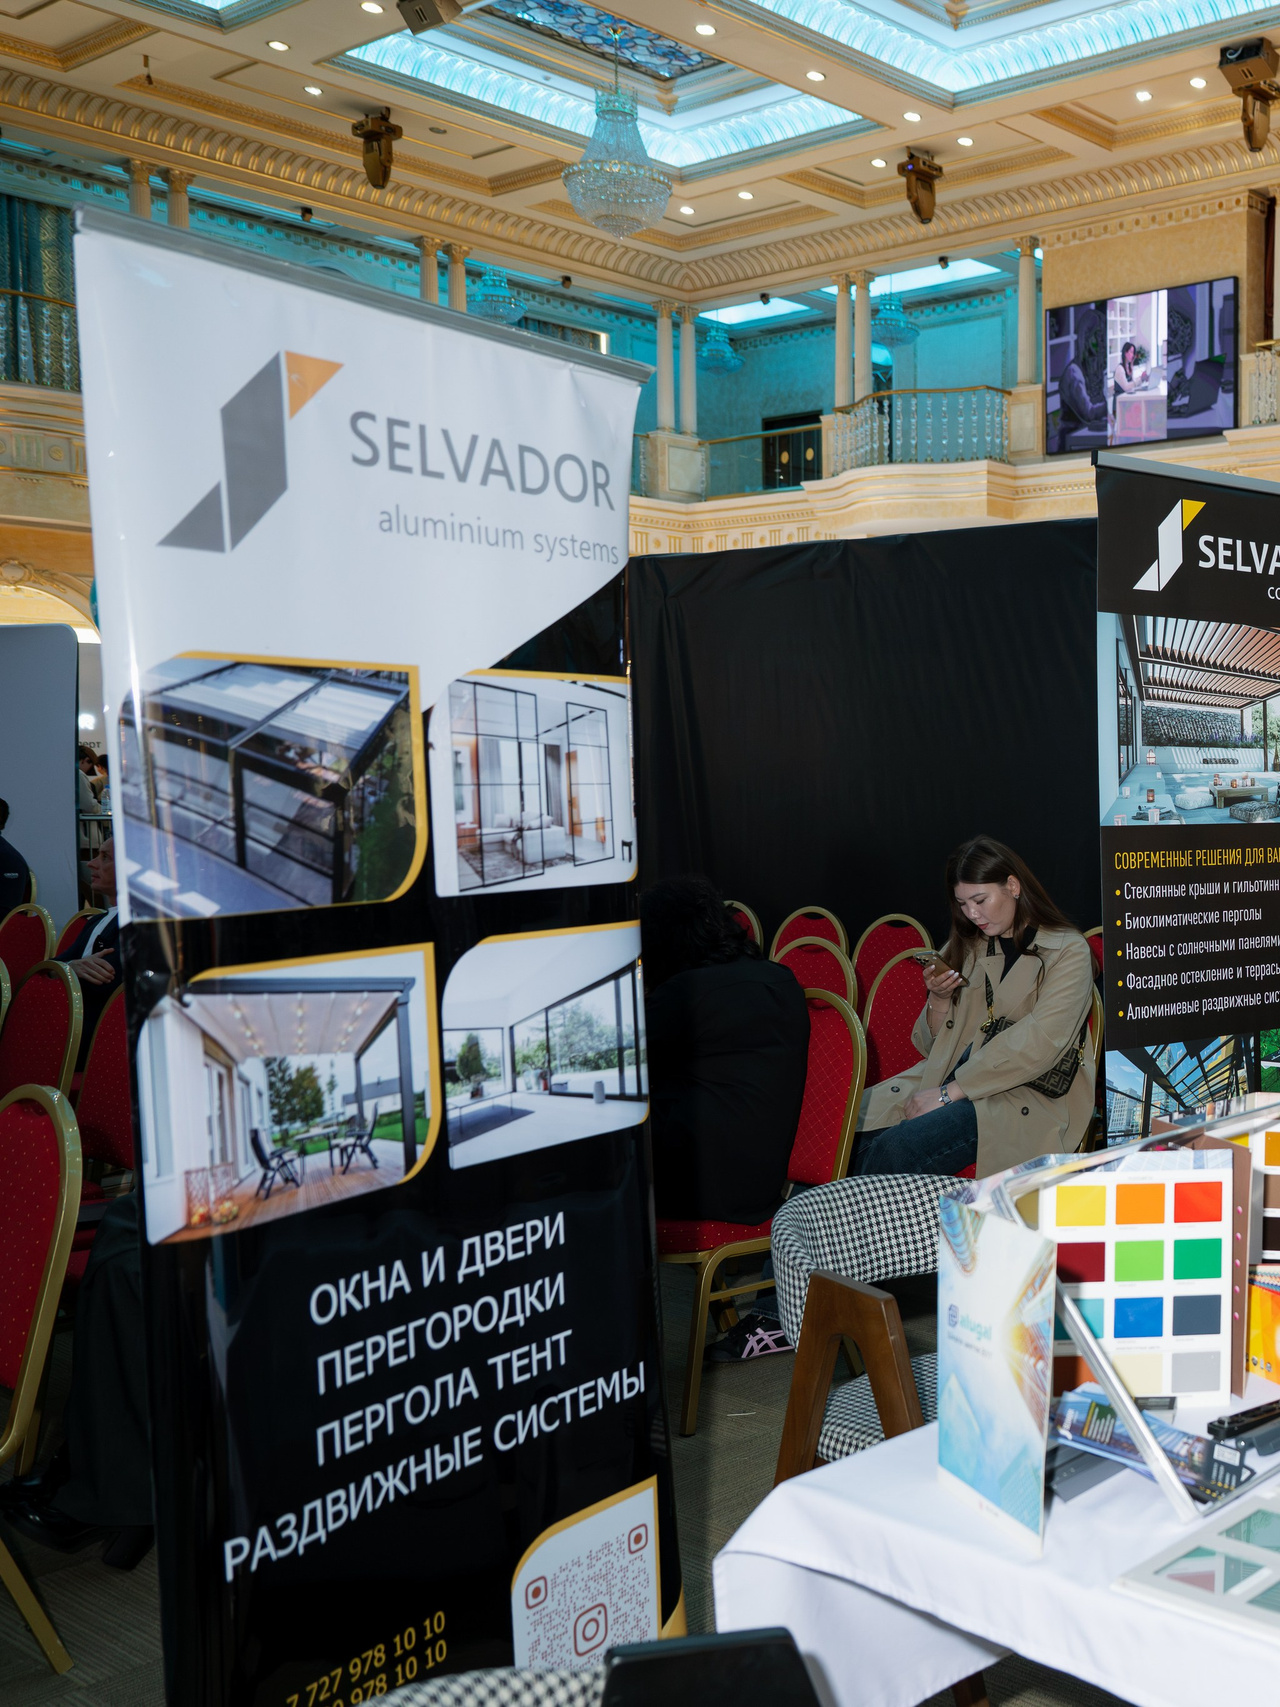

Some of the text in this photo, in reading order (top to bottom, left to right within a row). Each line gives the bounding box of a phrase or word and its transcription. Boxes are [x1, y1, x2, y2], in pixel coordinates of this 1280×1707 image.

[348, 410, 616, 511] SELVADOR
[378, 504, 619, 566] aluminium systems
[1114, 850, 1193, 870] СОВРЕМЕННЫЕ
[1196, 848, 1242, 867] РЕШЕНИЯ
[1244, 847, 1265, 867] ДЛЯ
[1124, 882, 1186, 900] Стеклянные
[1188, 882, 1221, 900] крыши
[1223, 881, 1230, 894] и
[1125, 908, 1262, 930] Биоклиматические перголы
[1126, 942, 1166, 960] Навесы
[1168, 943, 1175, 957] с
[1177, 938, 1236, 956] солнечными
[1126, 972, 1178, 990] Фасадное
[1180, 967, 1234, 985] остекление
[1236, 966, 1243, 979] и
[1126, 1000, 1200, 1020] Алюминиевые
[1202, 993, 1262, 1015] раздвижные
[308, 1210, 567, 1327] ОКНА И ДВЕРИ
[316, 1271, 567, 1396] ПЕРЕГОРОДКИ
[316, 1329, 573, 1467] ПЕРГОЛА ТЕНТ
[223, 1361, 646, 1583] РАЗДВИЖНЫЕ СИСТЕМЫ
[306, 1667, 342, 1707] 727
[348, 1643, 386, 1683] 978
[393, 1627, 416, 1658] 10
[423, 1610, 446, 1641] 10
[395, 1656, 418, 1688] 10
[424, 1639, 448, 1670] 10
